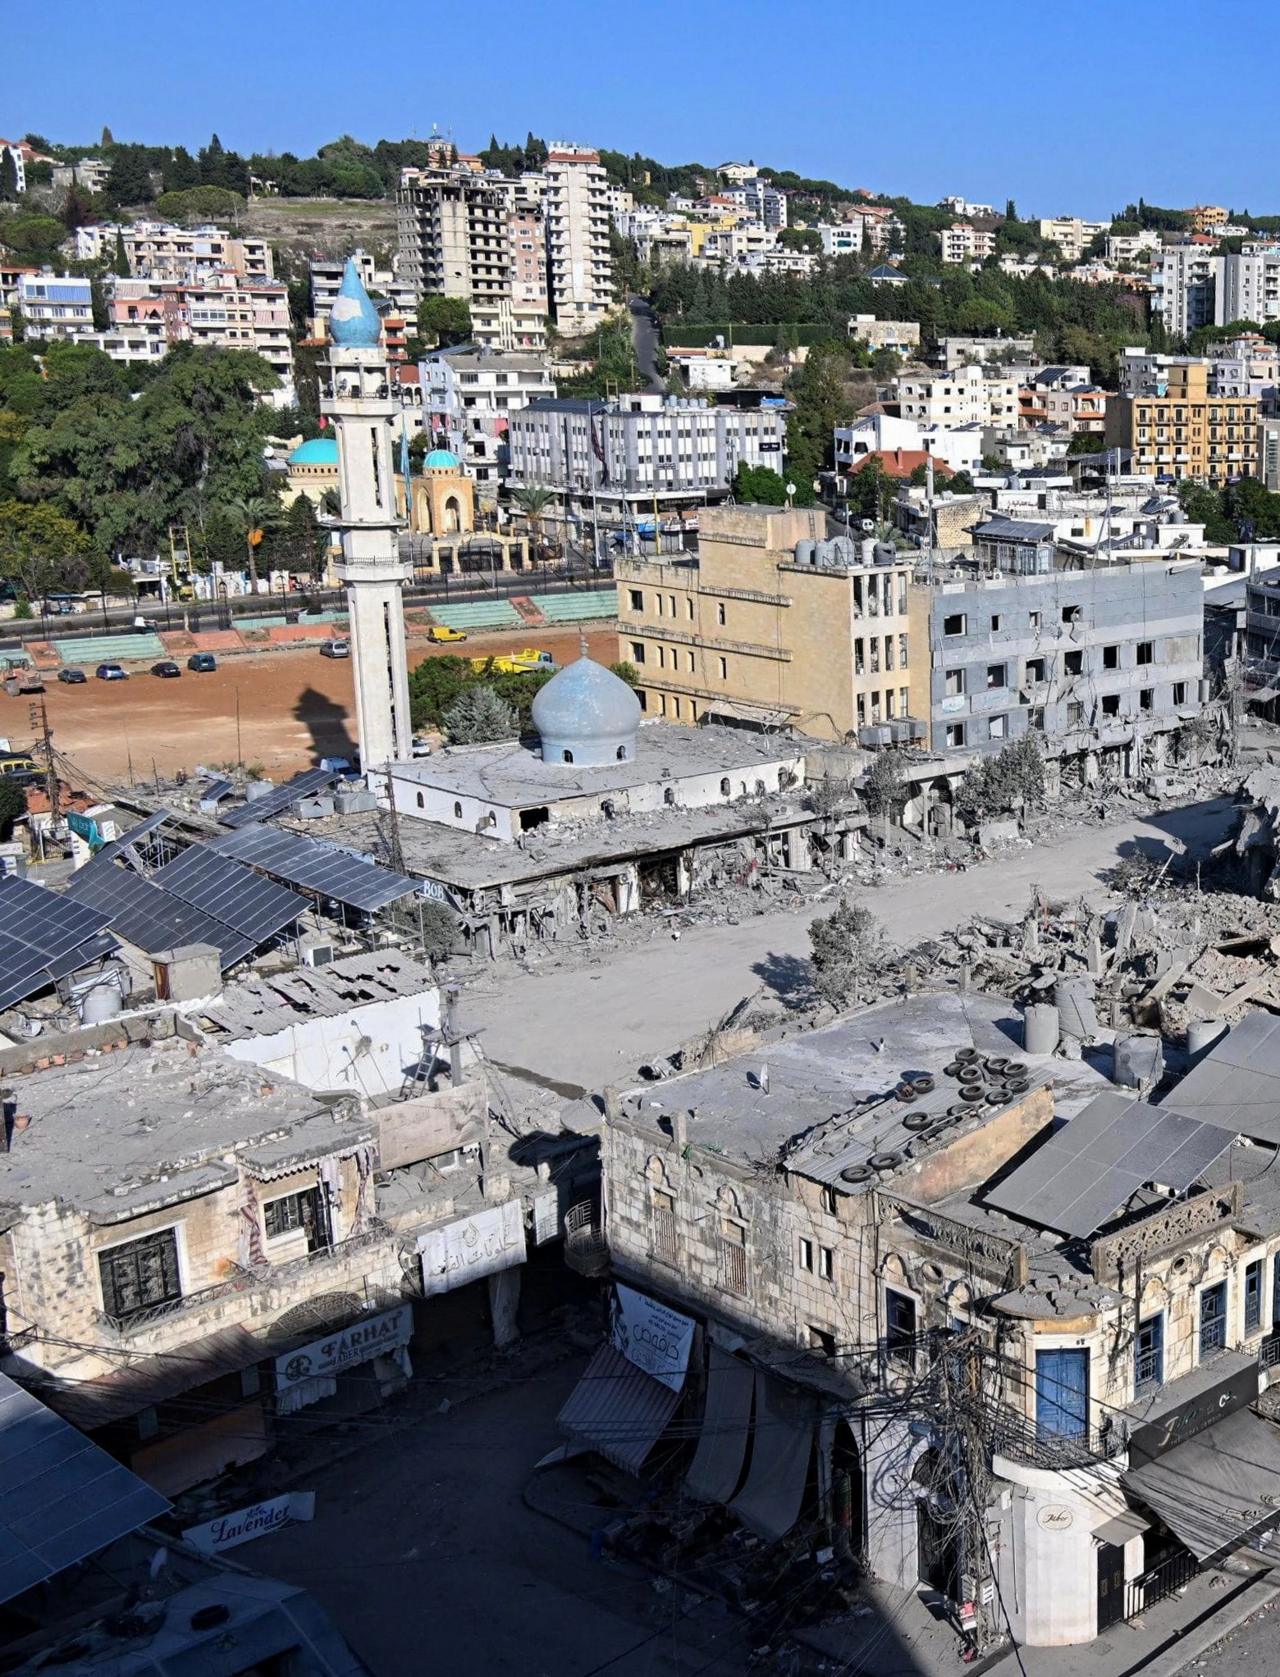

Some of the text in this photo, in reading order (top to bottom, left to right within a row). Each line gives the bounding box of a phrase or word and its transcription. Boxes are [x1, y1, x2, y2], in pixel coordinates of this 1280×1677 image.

[467, 1232, 519, 1265] حلويات
[321, 1310, 403, 1357] FARHAT
[210, 1505, 290, 1544] Lavender
